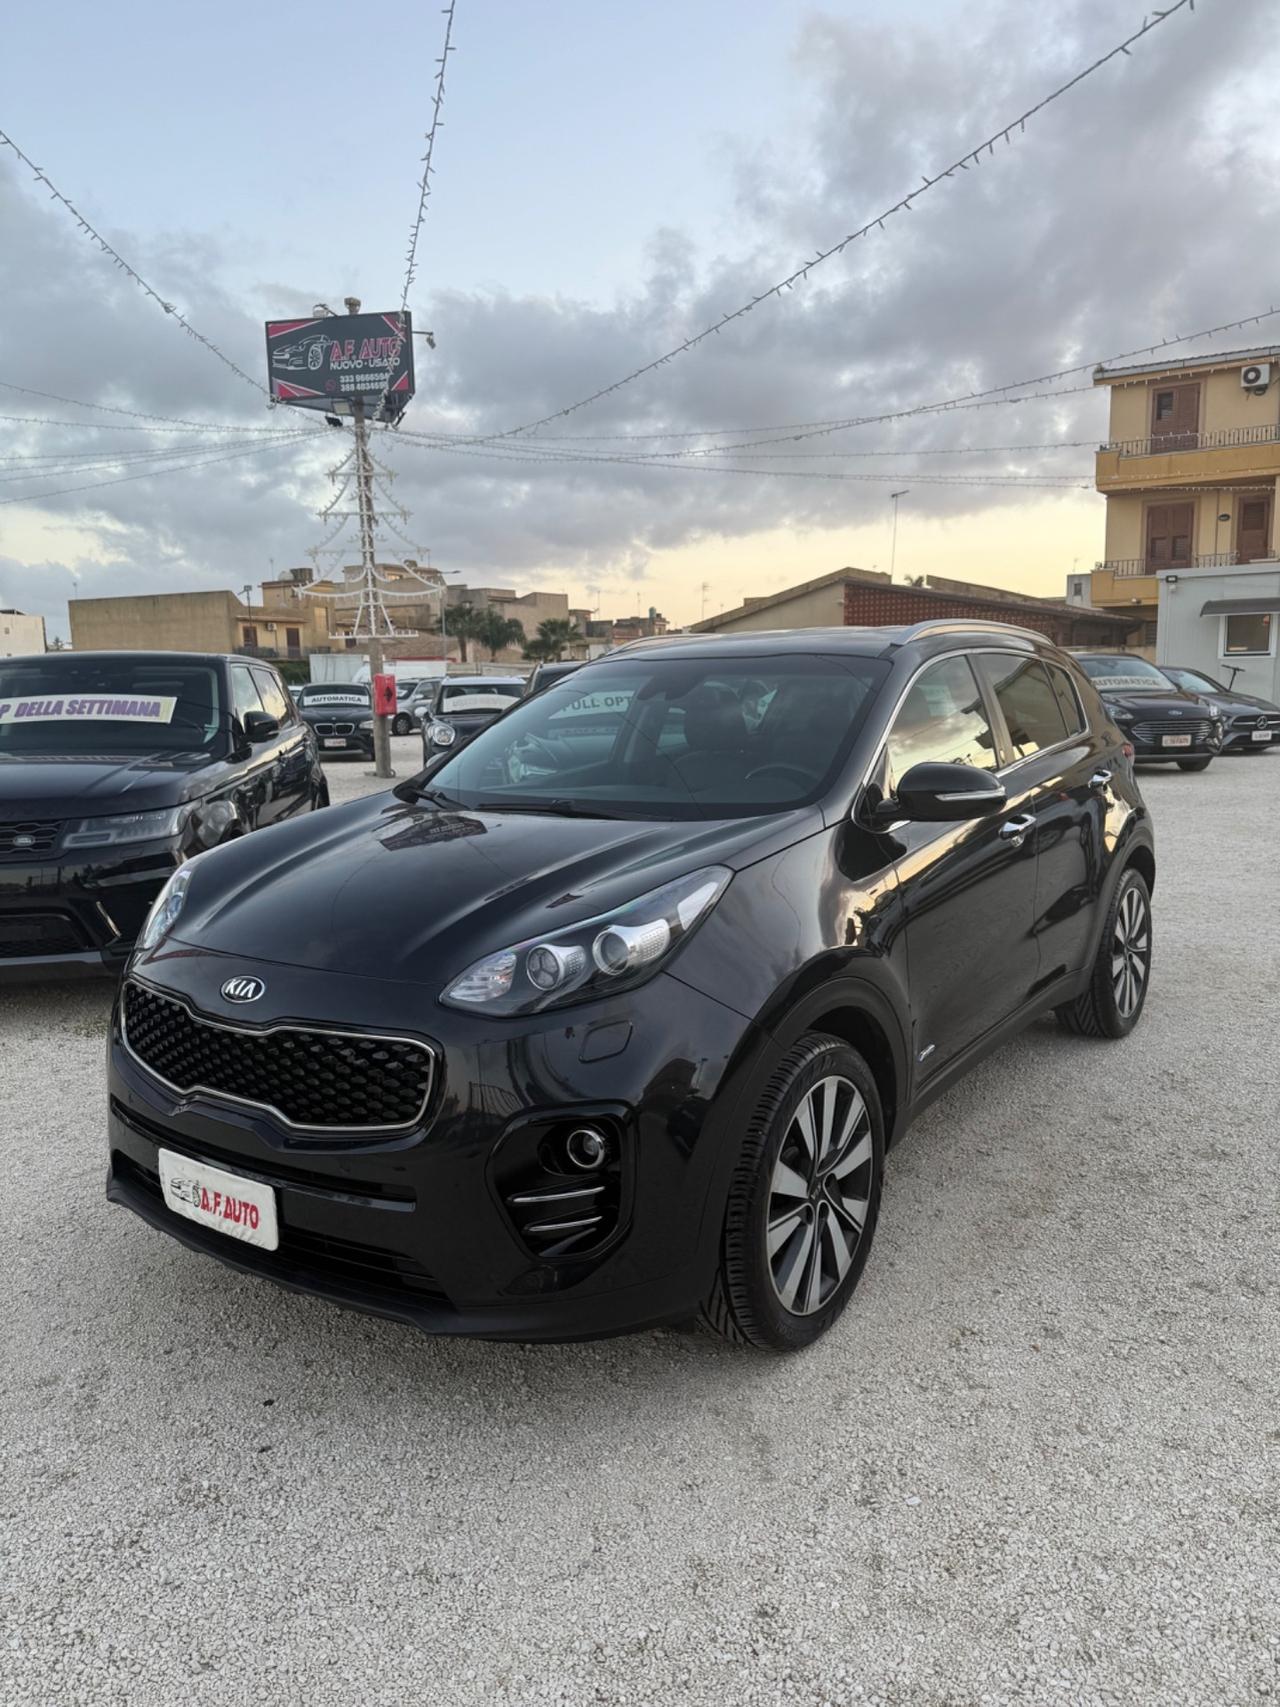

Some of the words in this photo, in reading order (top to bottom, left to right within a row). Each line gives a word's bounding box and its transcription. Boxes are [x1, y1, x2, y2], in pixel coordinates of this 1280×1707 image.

[359, 337, 401, 359] AUTO
[330, 360, 363, 370] NUOVO
[368, 357, 401, 368] USATO
[340, 375, 355, 383] 333
[311, 695, 362, 704] AUTOMATICA
[14, 701, 64, 719] DELLA
[65, 699, 162, 718] SETTIMANA
[225, 979, 257, 998] KIA
